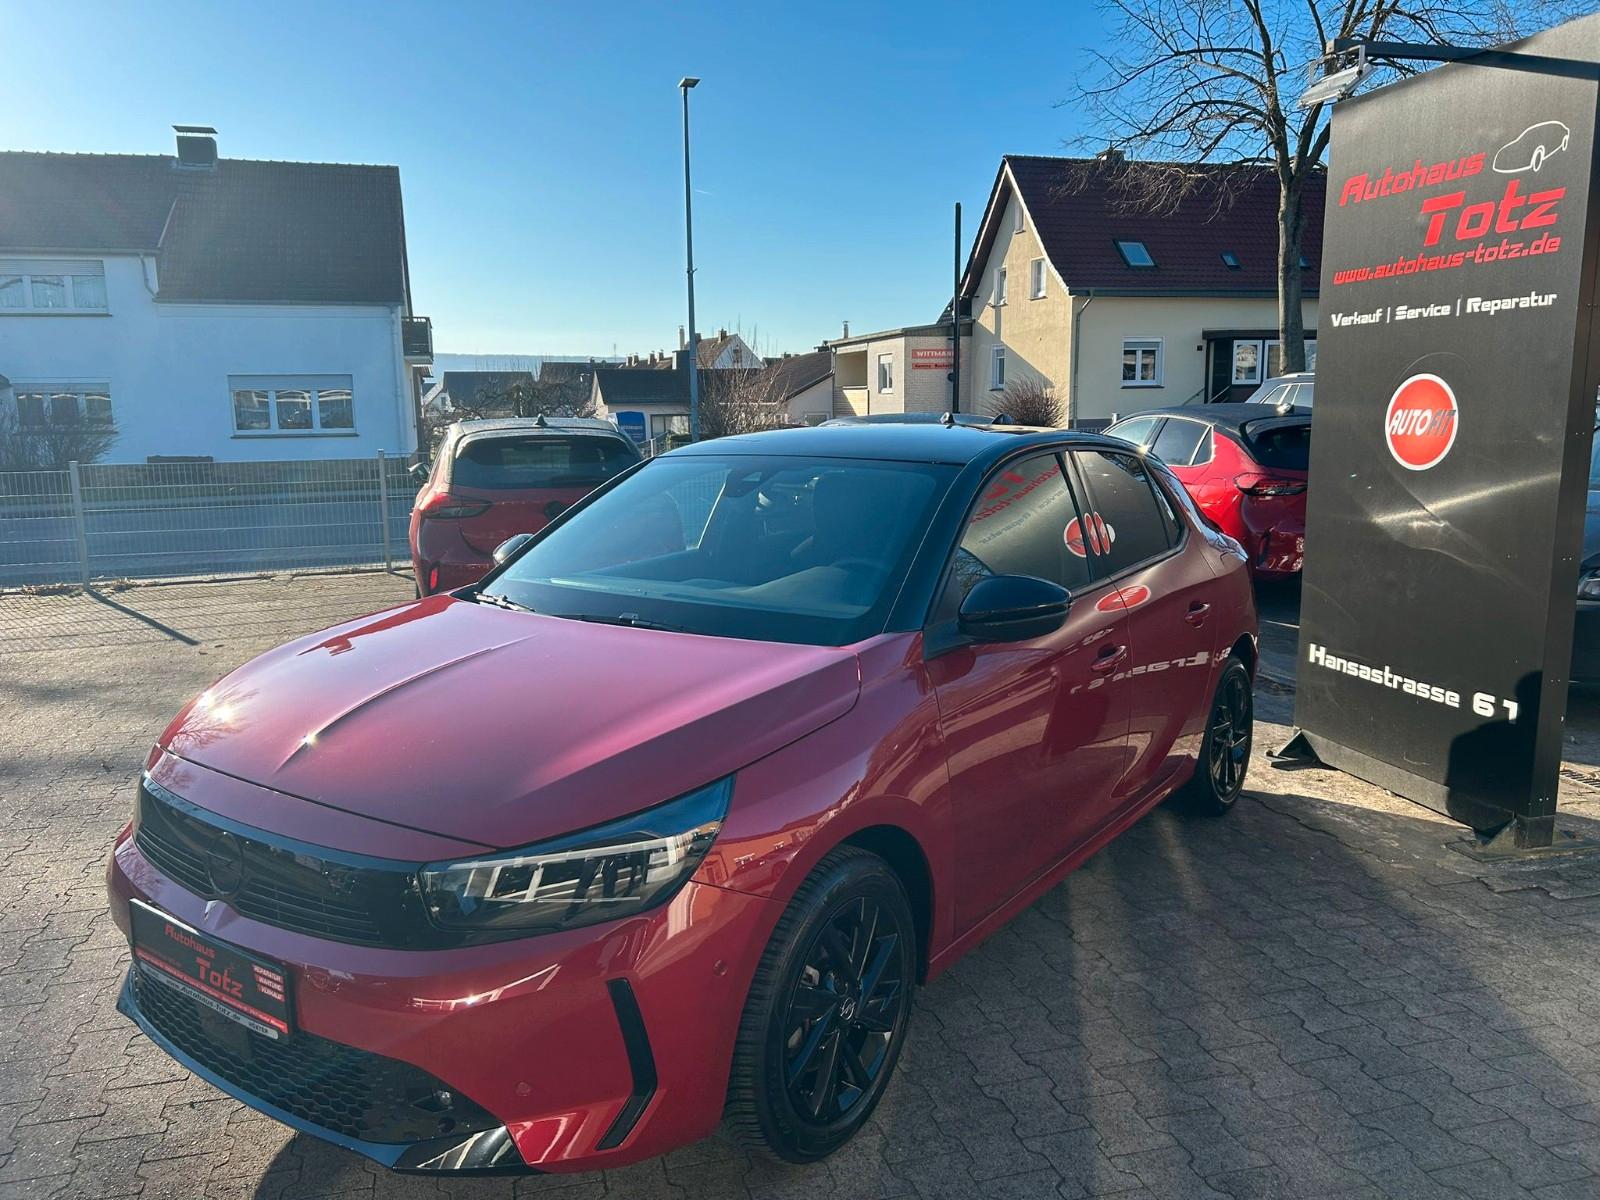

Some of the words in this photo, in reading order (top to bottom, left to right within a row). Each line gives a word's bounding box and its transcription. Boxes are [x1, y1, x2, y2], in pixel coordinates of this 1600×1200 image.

[1338, 152, 1488, 207] Autohaus
[1420, 179, 1566, 247] Totz
[1333, 232, 1561, 285] www.autohaus-totz.de
[1331, 309, 1383, 327] Verkauf
[1395, 303, 1451, 320] Service
[1466, 291, 1557, 315] Reparatur
[1389, 409, 1457, 436] AUTOFIT
[1308, 642, 1460, 708] Hansastrasse
[164, 923, 216, 958] Autohaus
[195, 957, 243, 998] Totz
